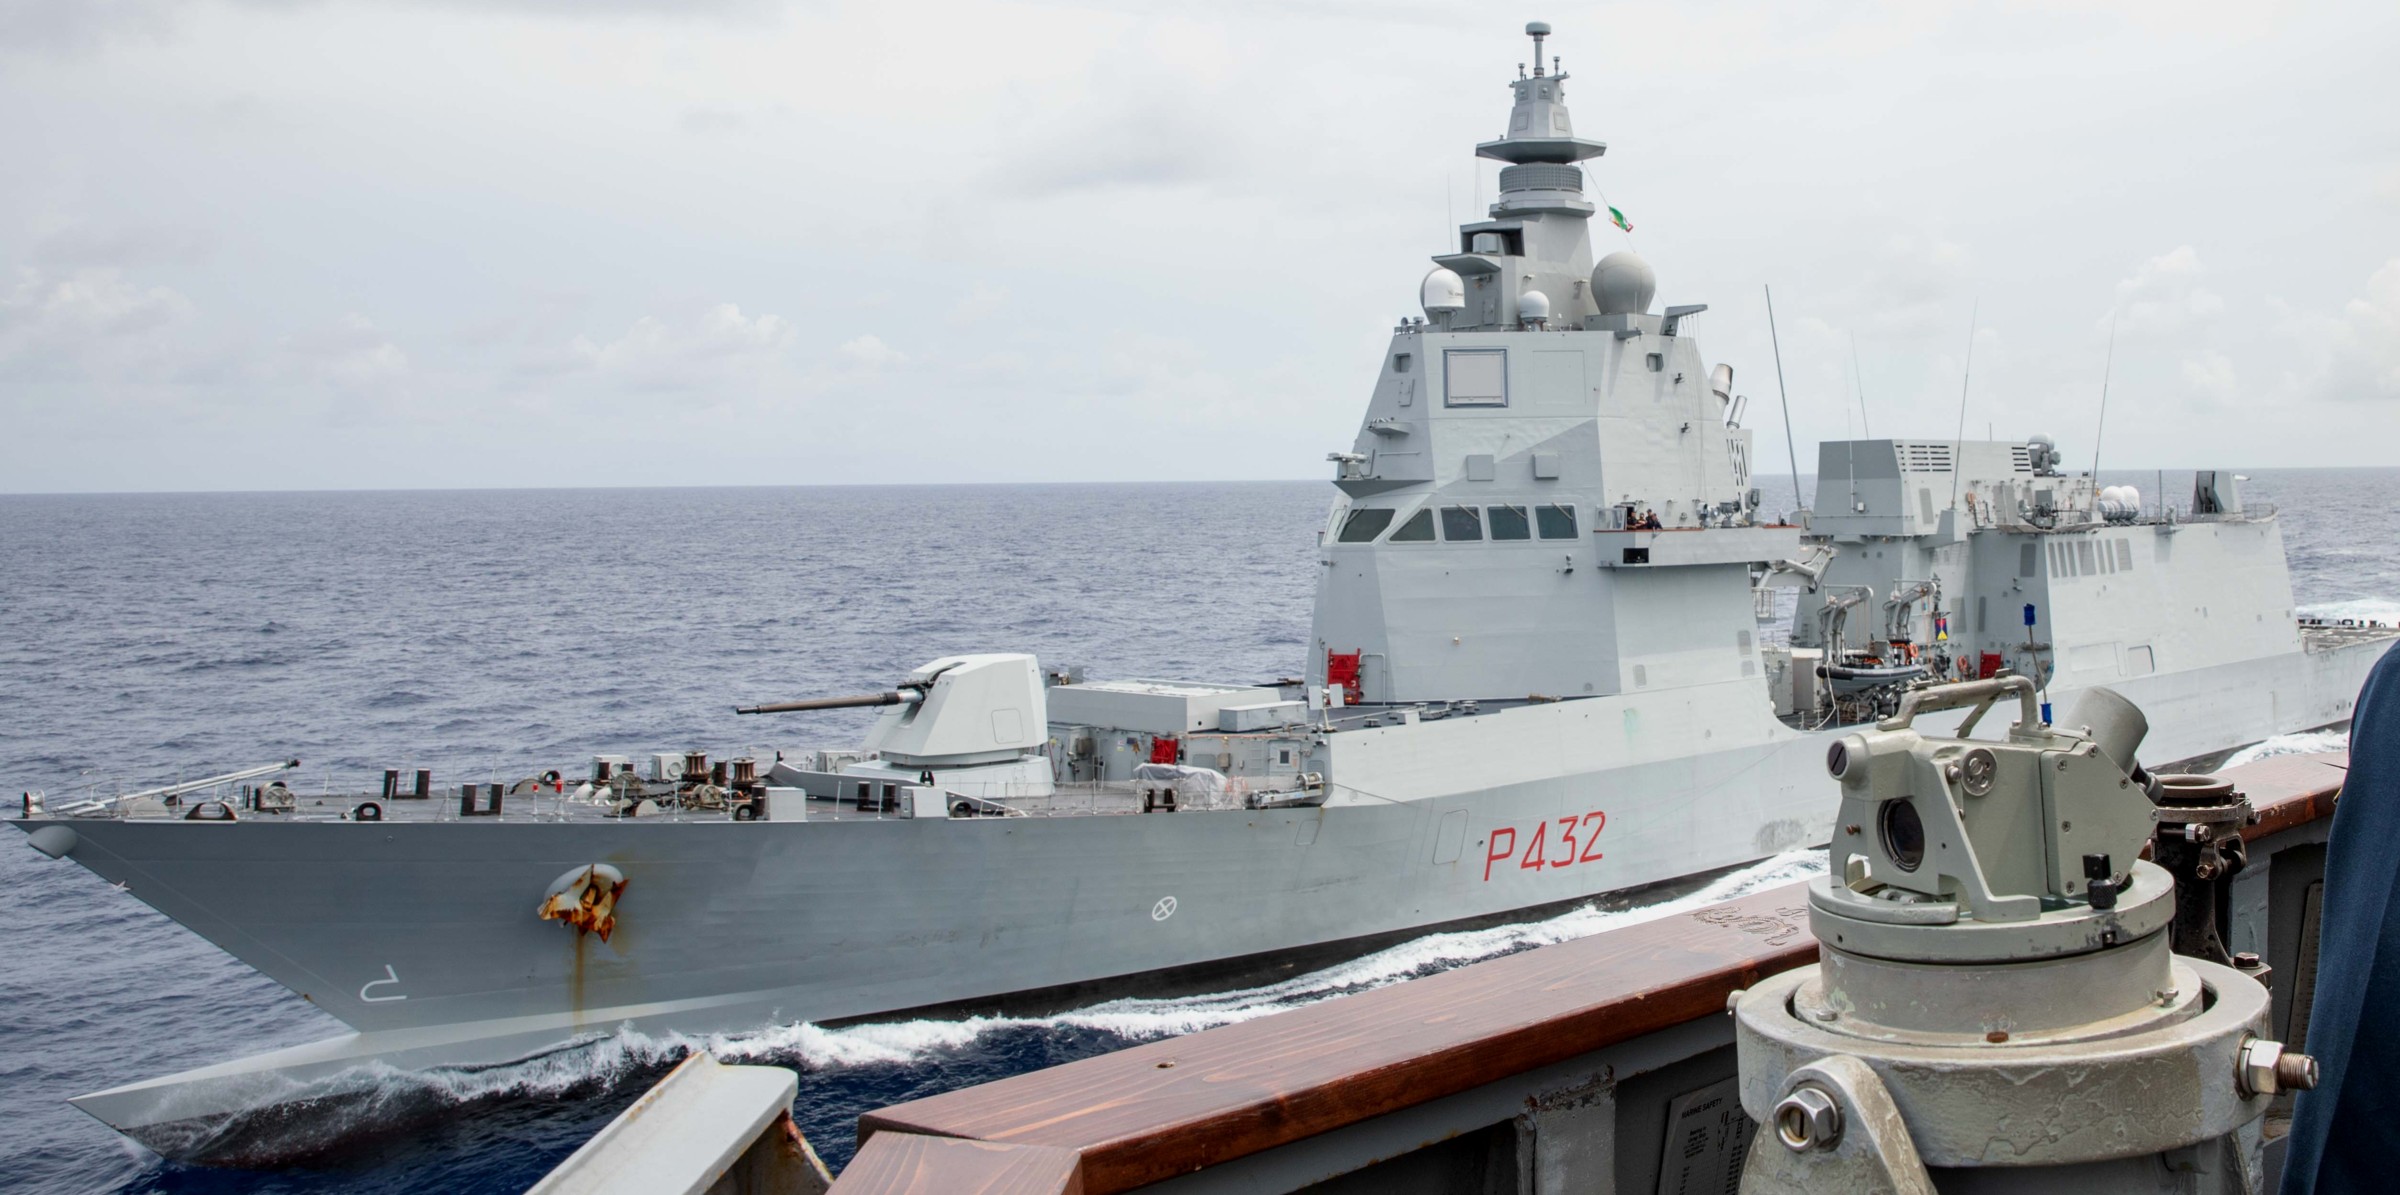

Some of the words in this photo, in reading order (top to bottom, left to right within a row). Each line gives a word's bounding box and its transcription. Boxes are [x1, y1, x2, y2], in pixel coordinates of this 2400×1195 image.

[1484, 811, 1606, 881] P432
[1681, 1104, 1702, 1119] MARINE
[1702, 1097, 1723, 1111] SAFETY
